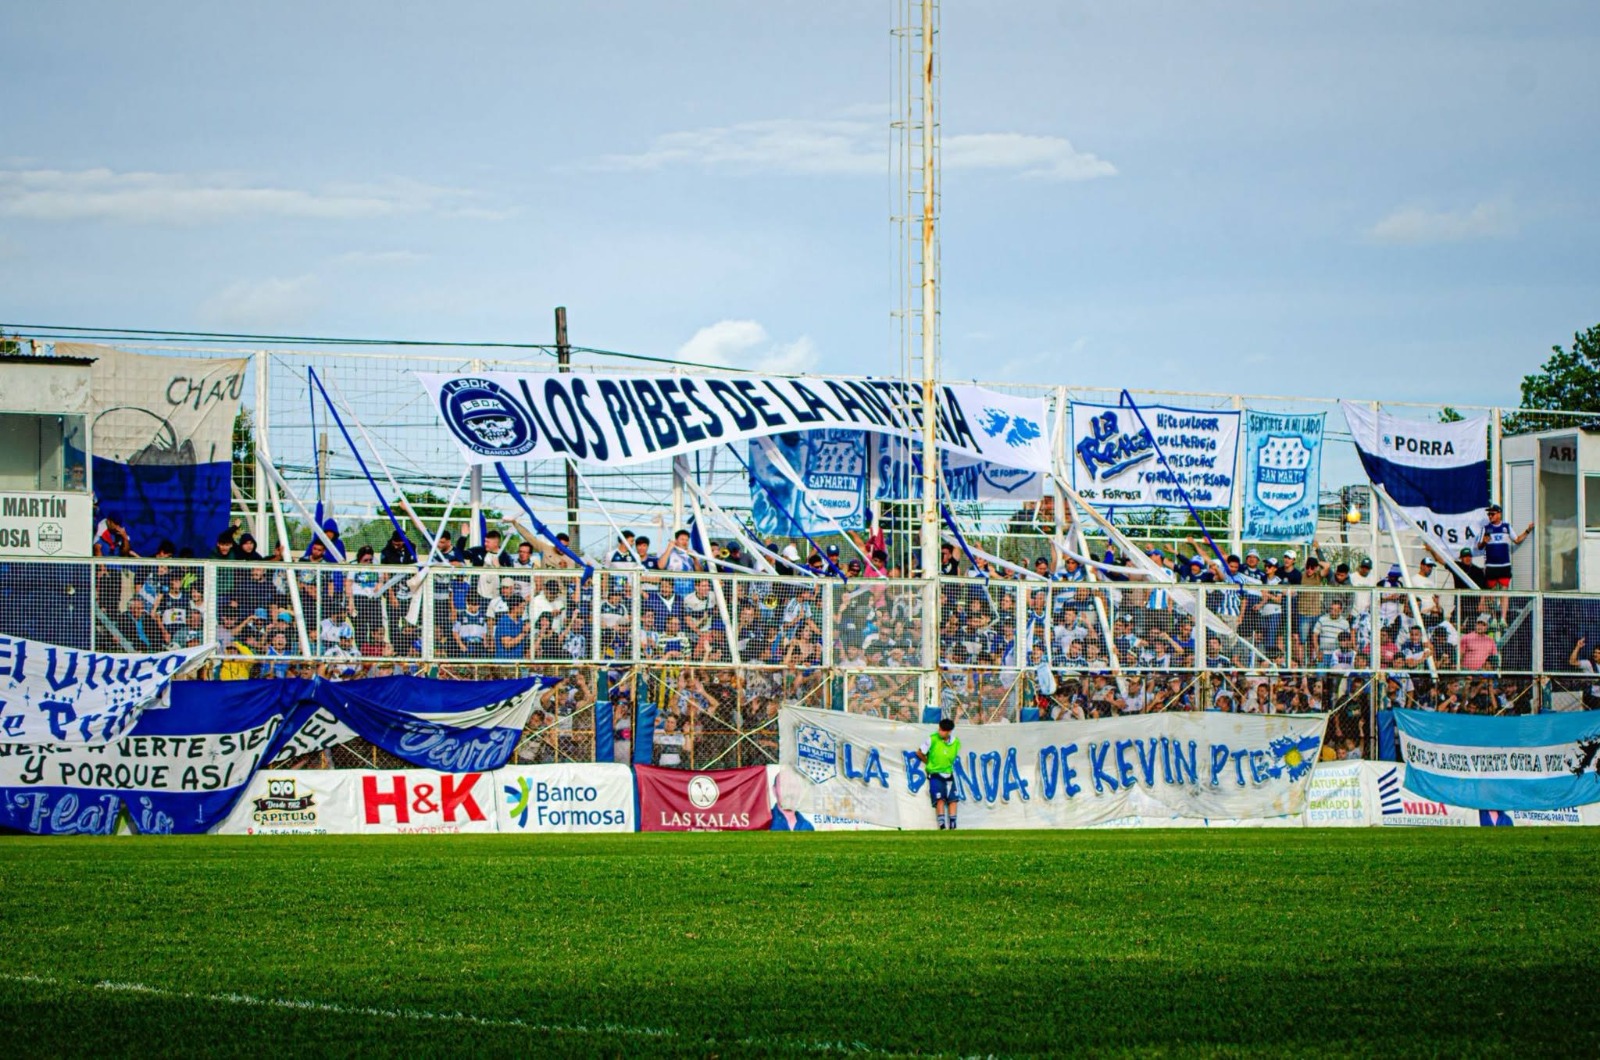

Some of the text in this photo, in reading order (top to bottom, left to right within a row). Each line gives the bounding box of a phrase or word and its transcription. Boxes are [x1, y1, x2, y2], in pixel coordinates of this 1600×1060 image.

[518, 378, 609, 462] LOS
[596, 378, 724, 458] PIBES
[704, 379, 788, 432] DE
[762, 380, 845, 423] LA
[1395, 435, 1455, 456] PORRA
[3, 495, 67, 518] MARTÍN
[843, 743, 889, 788] LA
[902, 747, 1030, 802] BNDA
[1038, 743, 1081, 800] DE
[1088, 737, 1198, 793] KEVIN
[1471, 753, 1508, 773] VERTE
[1509, 752, 1542, 773] OTRA
[59, 763, 170, 790] PORQUE
[181, 762, 235, 791] ASI
[362, 773, 487, 824] H&K
[536, 782, 598, 803] Banco
[253, 811, 317, 825] CAPITULO
[537, 805, 626, 826] Formosa
[1402, 801, 1448, 816] MIDA
[661, 811, 750, 828] LAS KALAS
